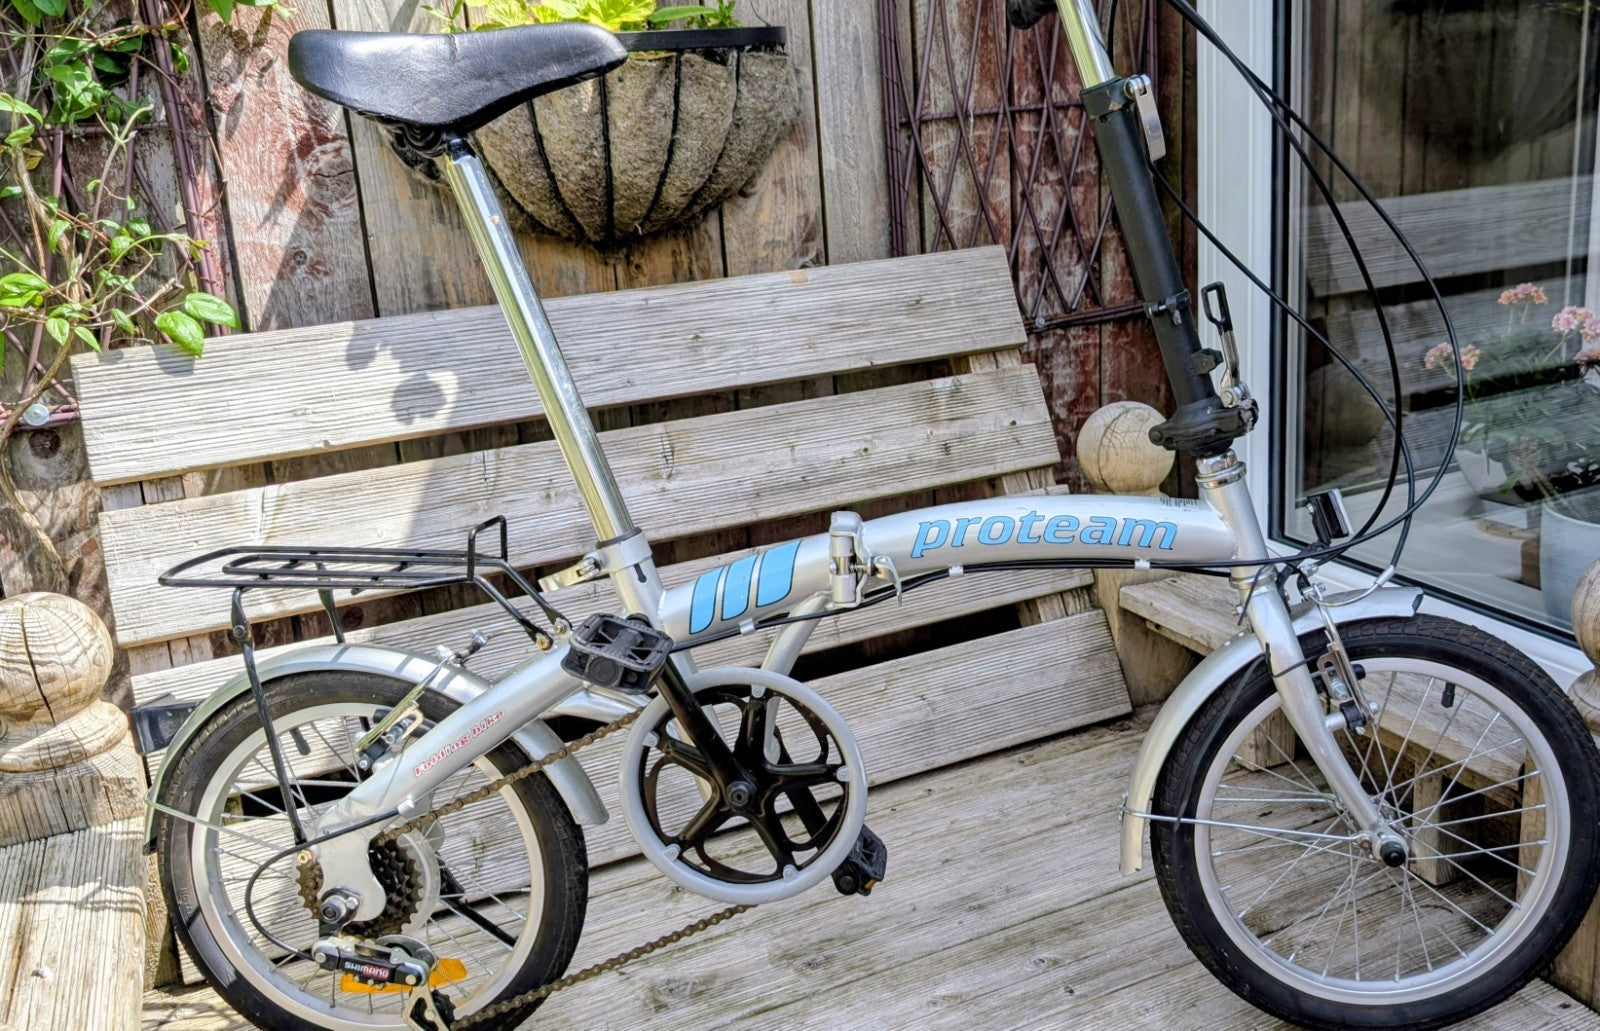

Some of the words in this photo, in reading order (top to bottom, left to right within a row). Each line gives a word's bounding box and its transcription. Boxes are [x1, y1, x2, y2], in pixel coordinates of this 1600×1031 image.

[911, 510, 1178, 558] proteam
[471, 710, 505, 737] bike
[344, 961, 390, 978] SHIMANO
